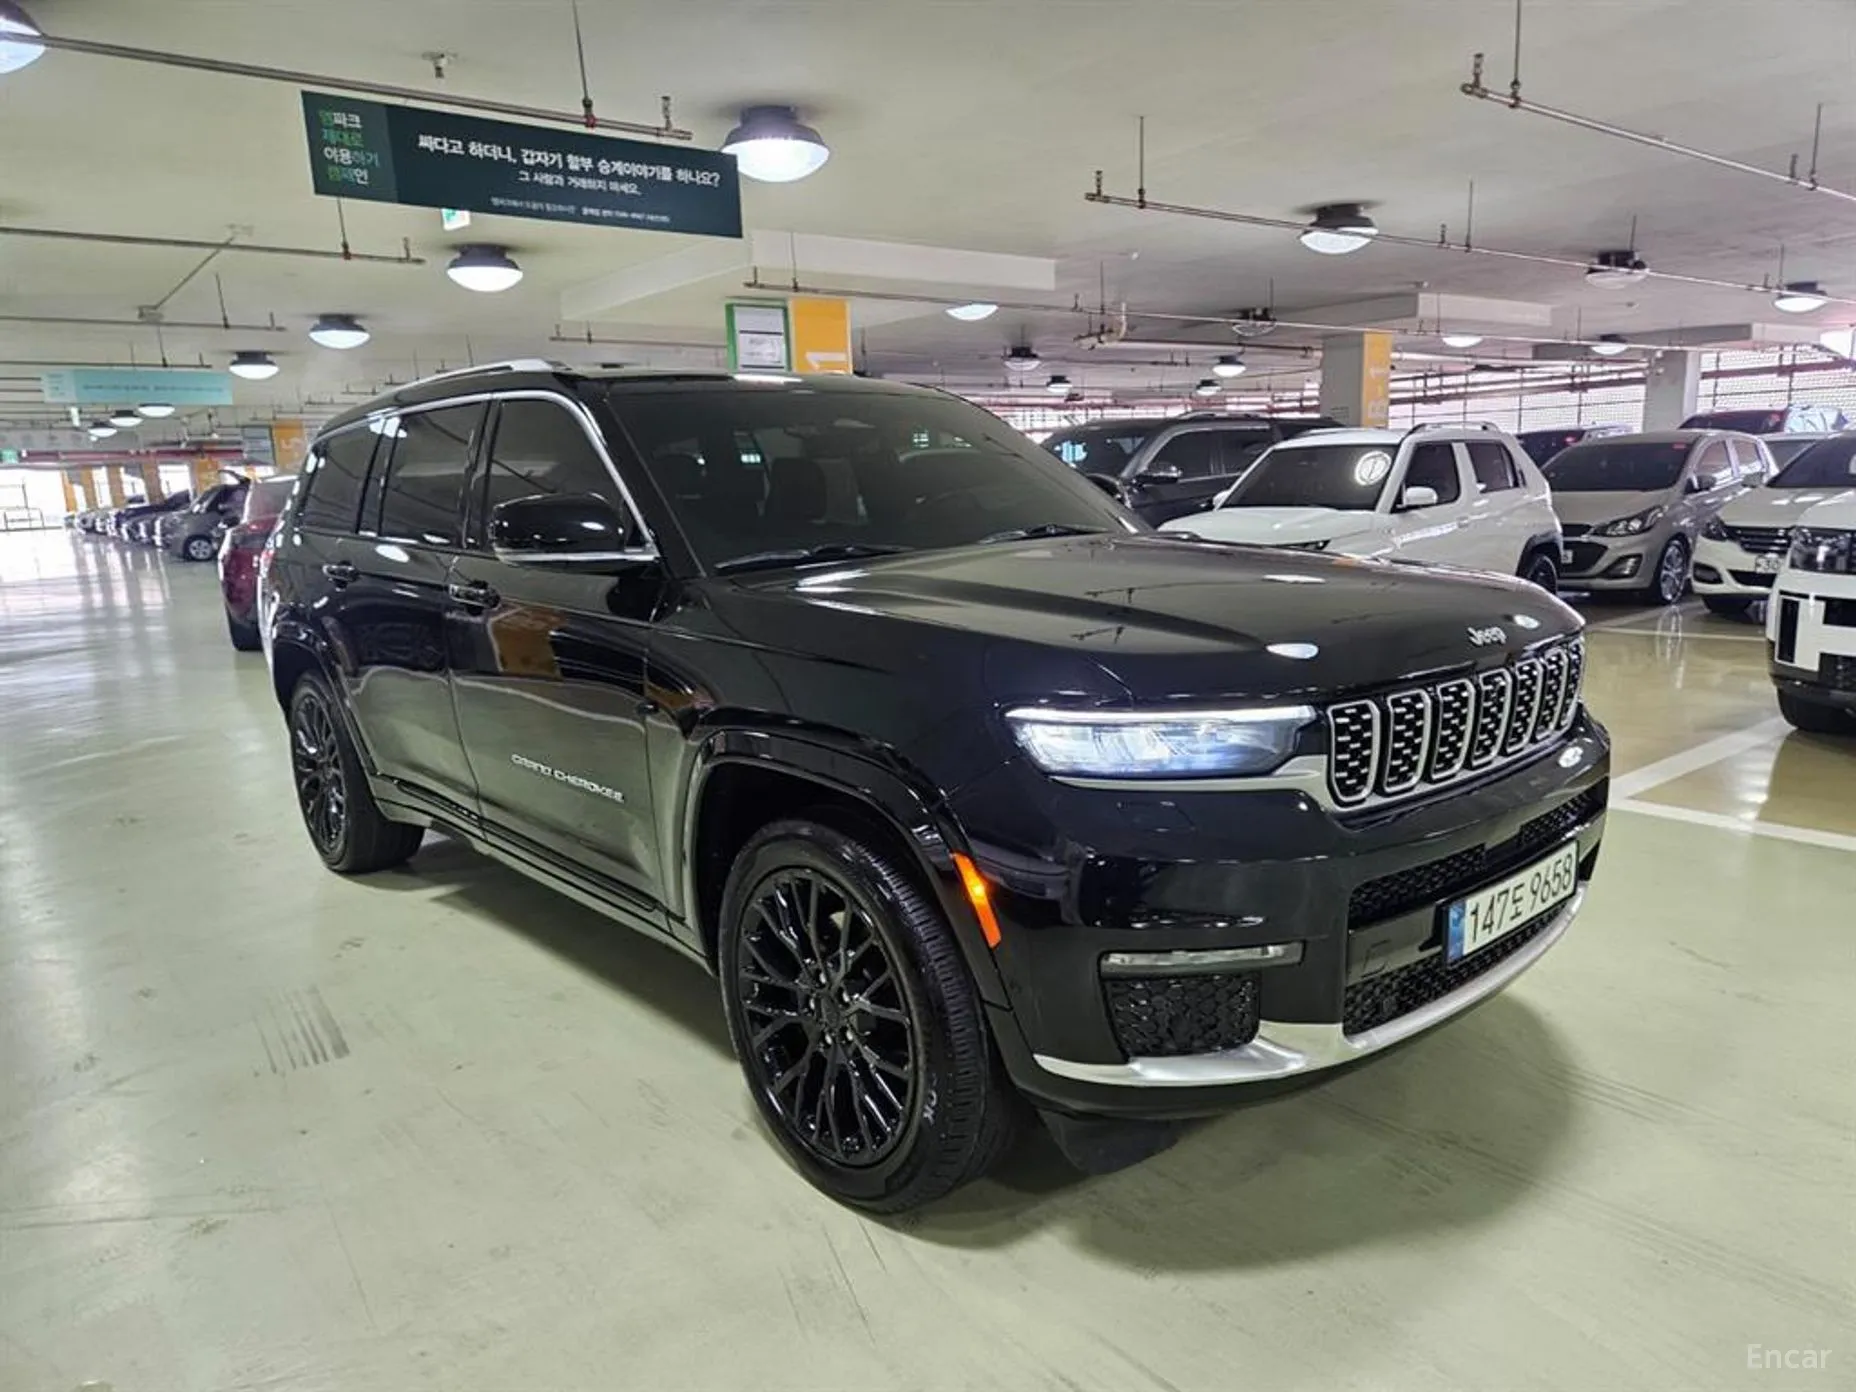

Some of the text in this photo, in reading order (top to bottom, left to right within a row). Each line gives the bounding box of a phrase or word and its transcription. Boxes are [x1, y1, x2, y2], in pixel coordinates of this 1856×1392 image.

[418, 133, 465, 154] 싸다고
[468, 141, 518, 164] 하더니,
[520, 148, 563, 169] 갑자기
[676, 168, 721, 188] 하나요?
[518, 170, 530, 181] 그
[1467, 627, 1506, 646] Jeep
